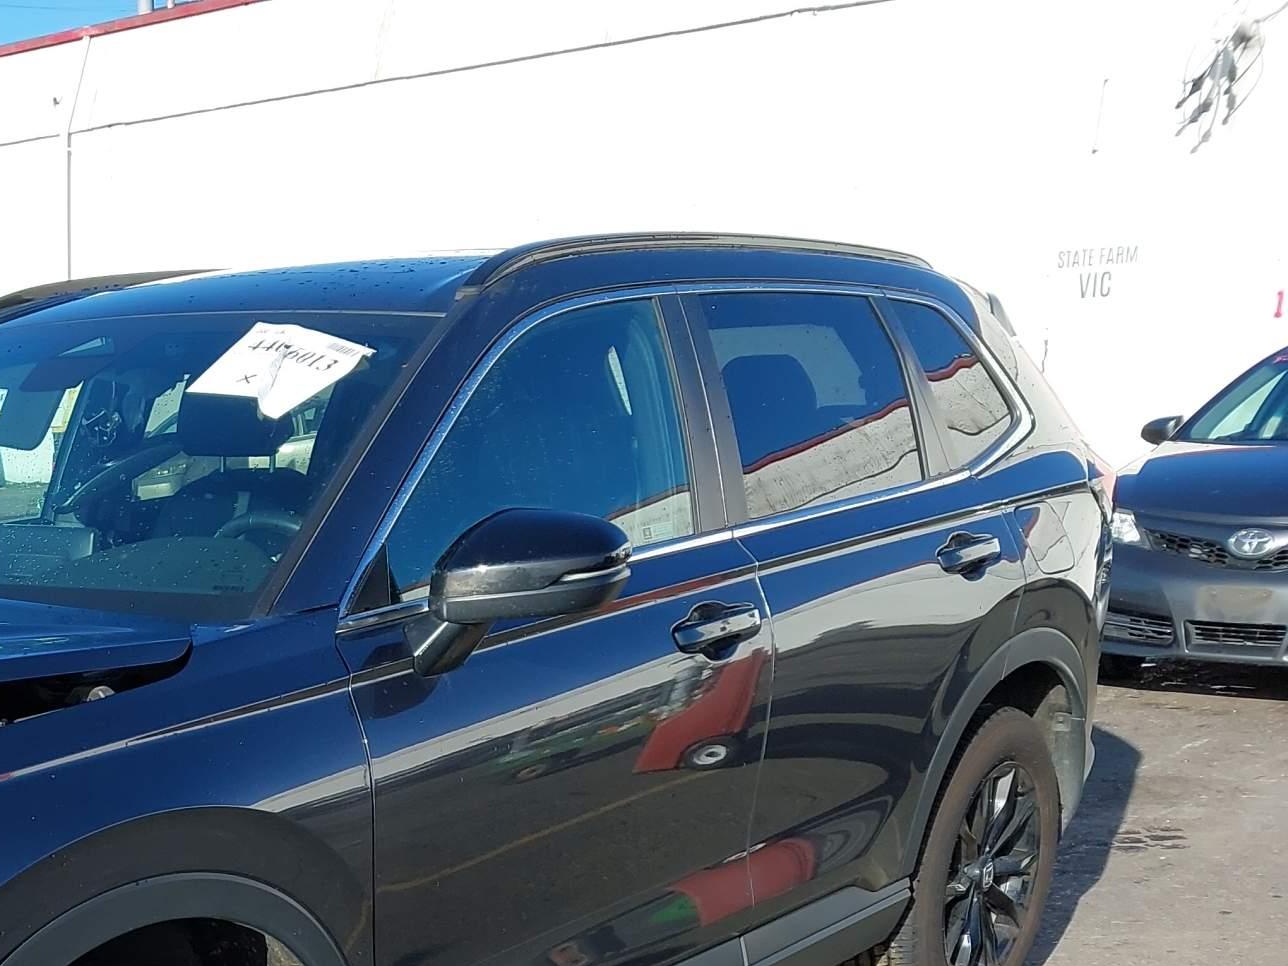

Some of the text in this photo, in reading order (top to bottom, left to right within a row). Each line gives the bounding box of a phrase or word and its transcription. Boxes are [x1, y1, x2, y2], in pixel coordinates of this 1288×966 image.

[1057, 245, 1139, 269] STATE FARM
[1079, 271, 1112, 299] VIC
